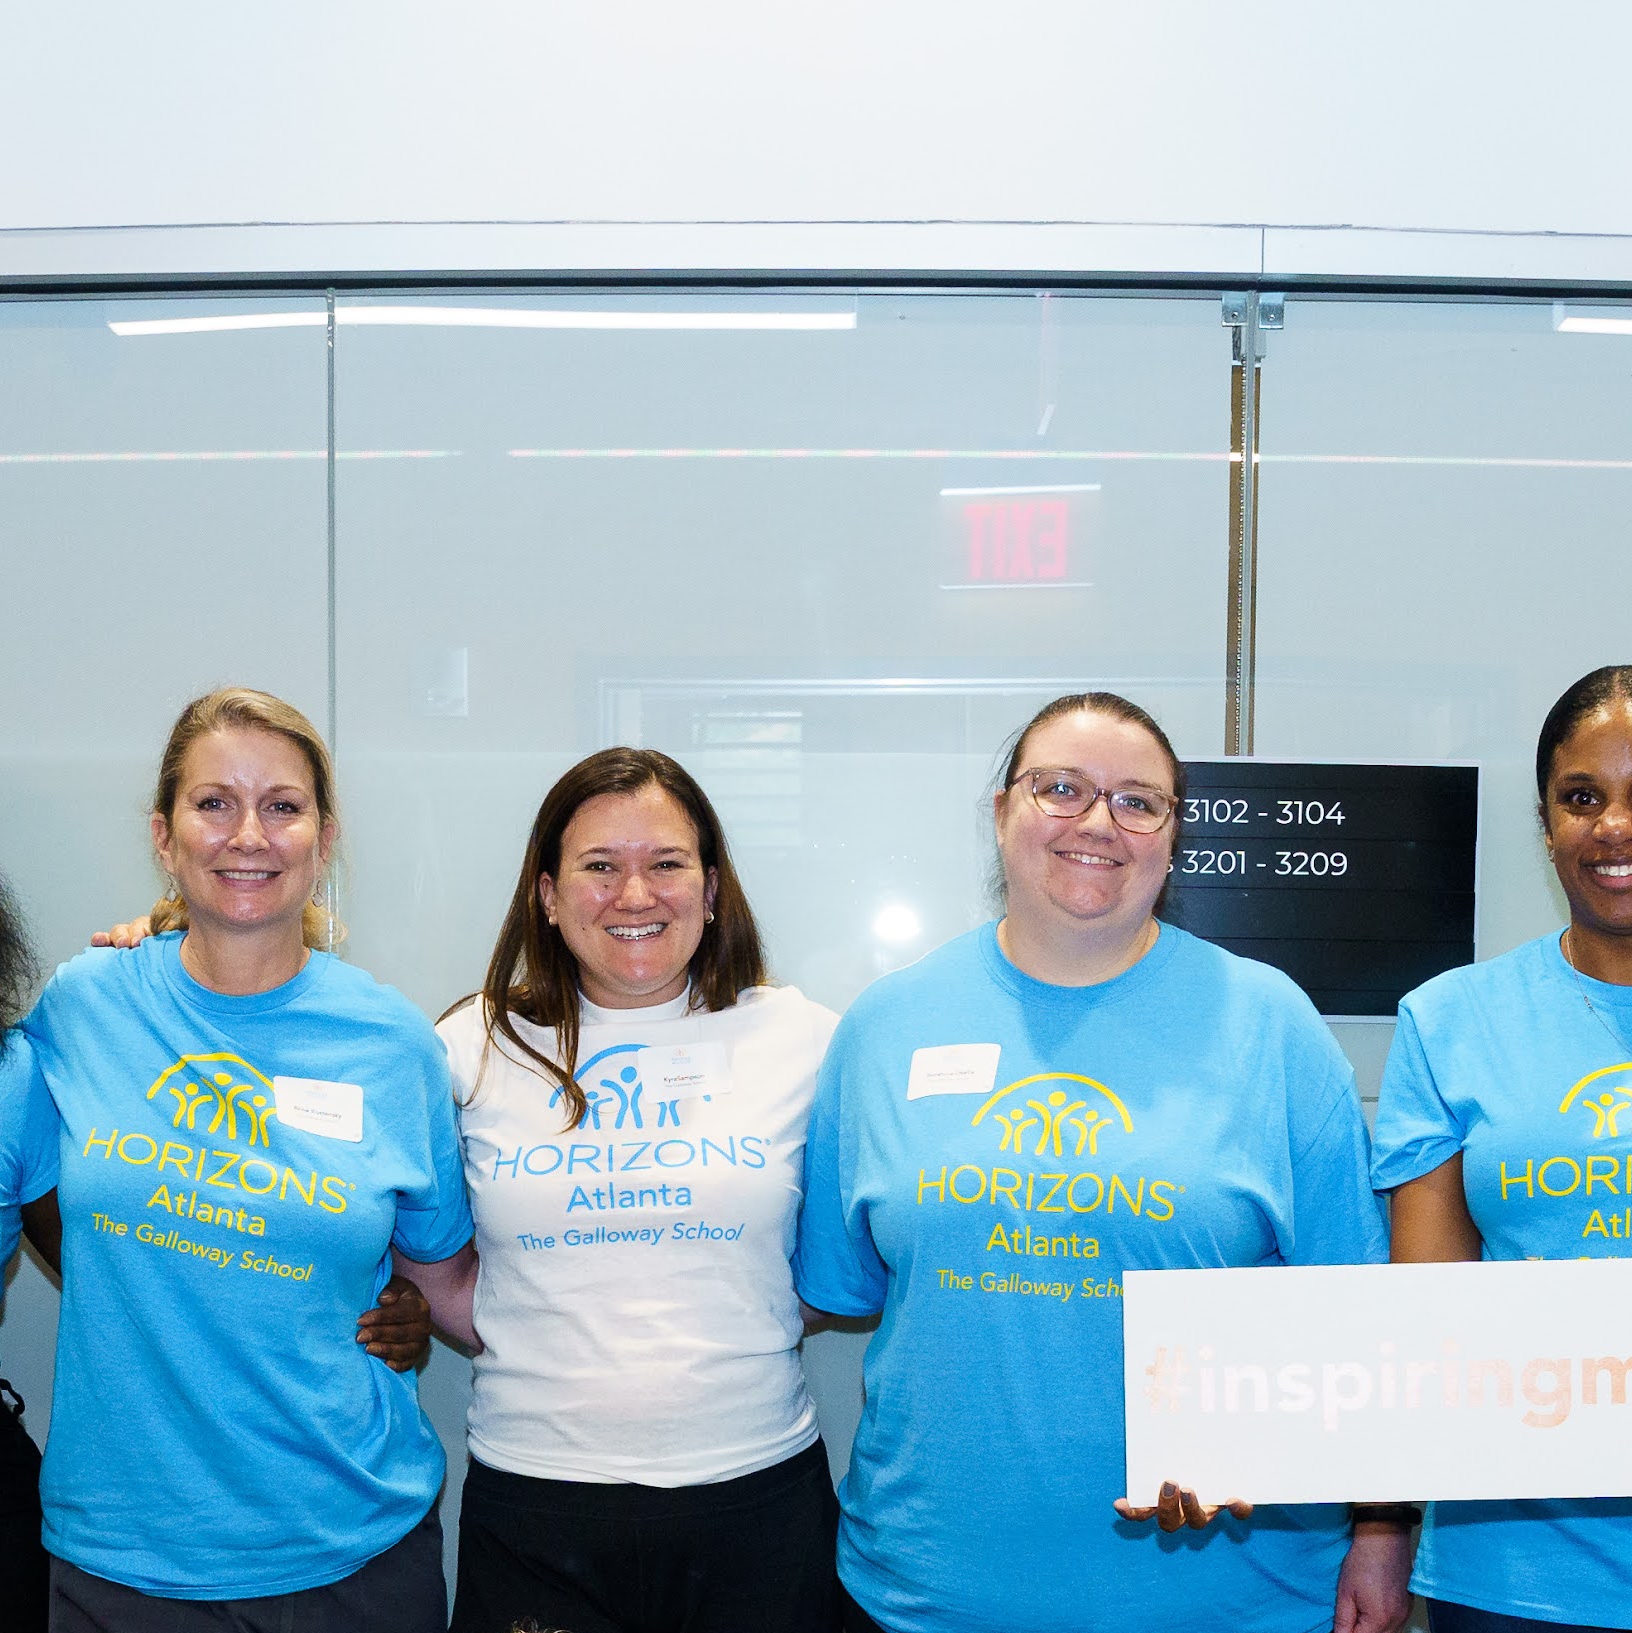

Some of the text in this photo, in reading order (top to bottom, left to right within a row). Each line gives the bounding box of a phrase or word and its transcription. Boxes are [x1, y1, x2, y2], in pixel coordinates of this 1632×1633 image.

[1183, 799, 1249, 824] 3102
[1276, 800, 1346, 825] 3104
[1182, 850, 1246, 875] 3201
[1274, 851, 1348, 876] 3209
[493, 1136, 767, 1181] HORIZONS
[147, 1184, 266, 1237] Atlanta
[567, 1182, 692, 1213] Atlanta
[918, 1164, 1176, 1222] HORIZONS
[92, 1213, 314, 1281] The Galloway School
[517, 1220, 745, 1250] The Galloway School
[986, 1222, 1100, 1259] Atlanta
[936, 1269, 973, 1290] The
[979, 1271, 1075, 1302] Galloway
